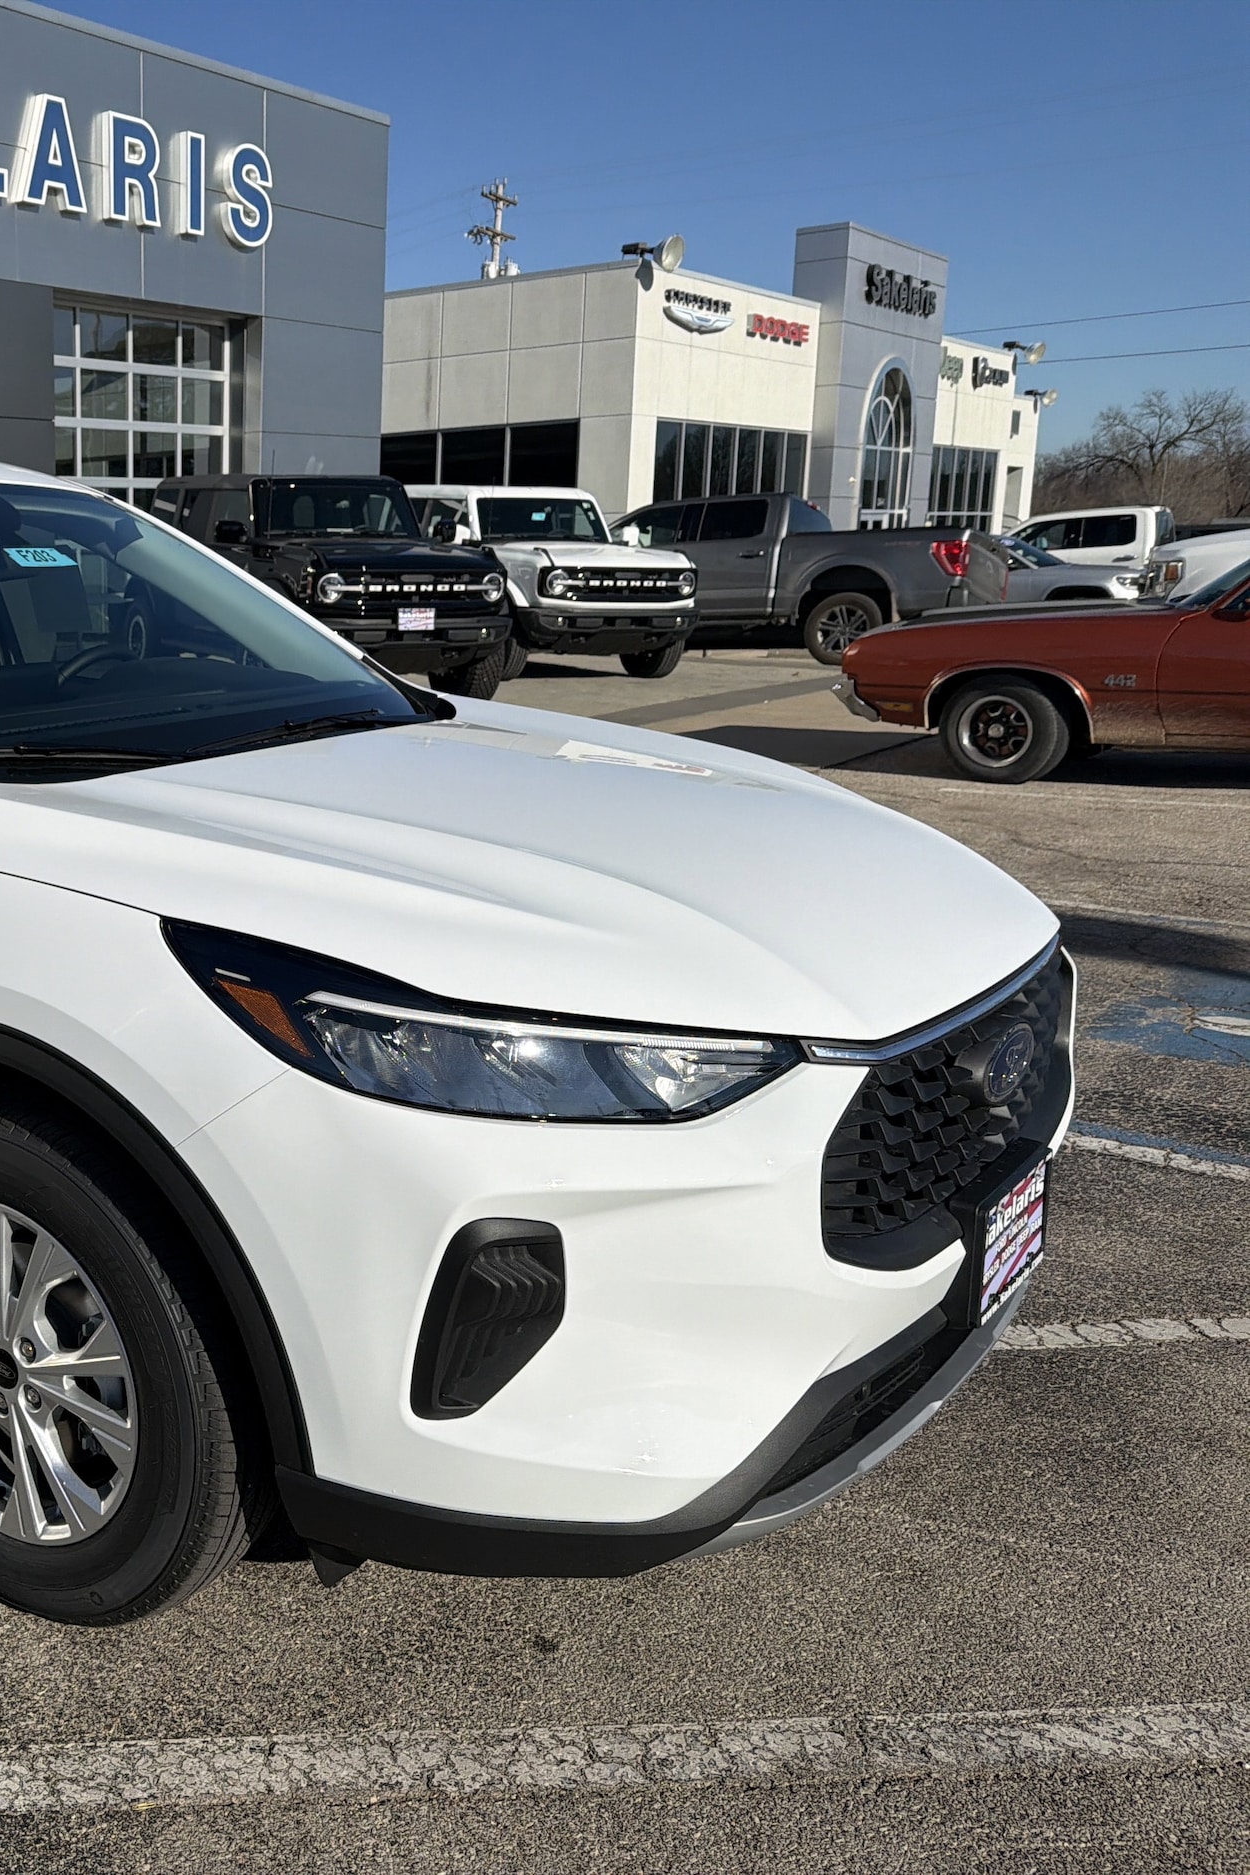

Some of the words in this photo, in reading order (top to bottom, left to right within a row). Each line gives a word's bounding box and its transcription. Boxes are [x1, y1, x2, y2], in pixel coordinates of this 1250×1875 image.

[866, 264, 937, 318] Sakelaris
[749, 313, 810, 344] DODGE
[17, 549, 57, 563] F203
[369, 584, 466, 592] BRONCO
[589, 580, 667, 588] BRONCO
[986, 1176, 1045, 1250] akelaris
